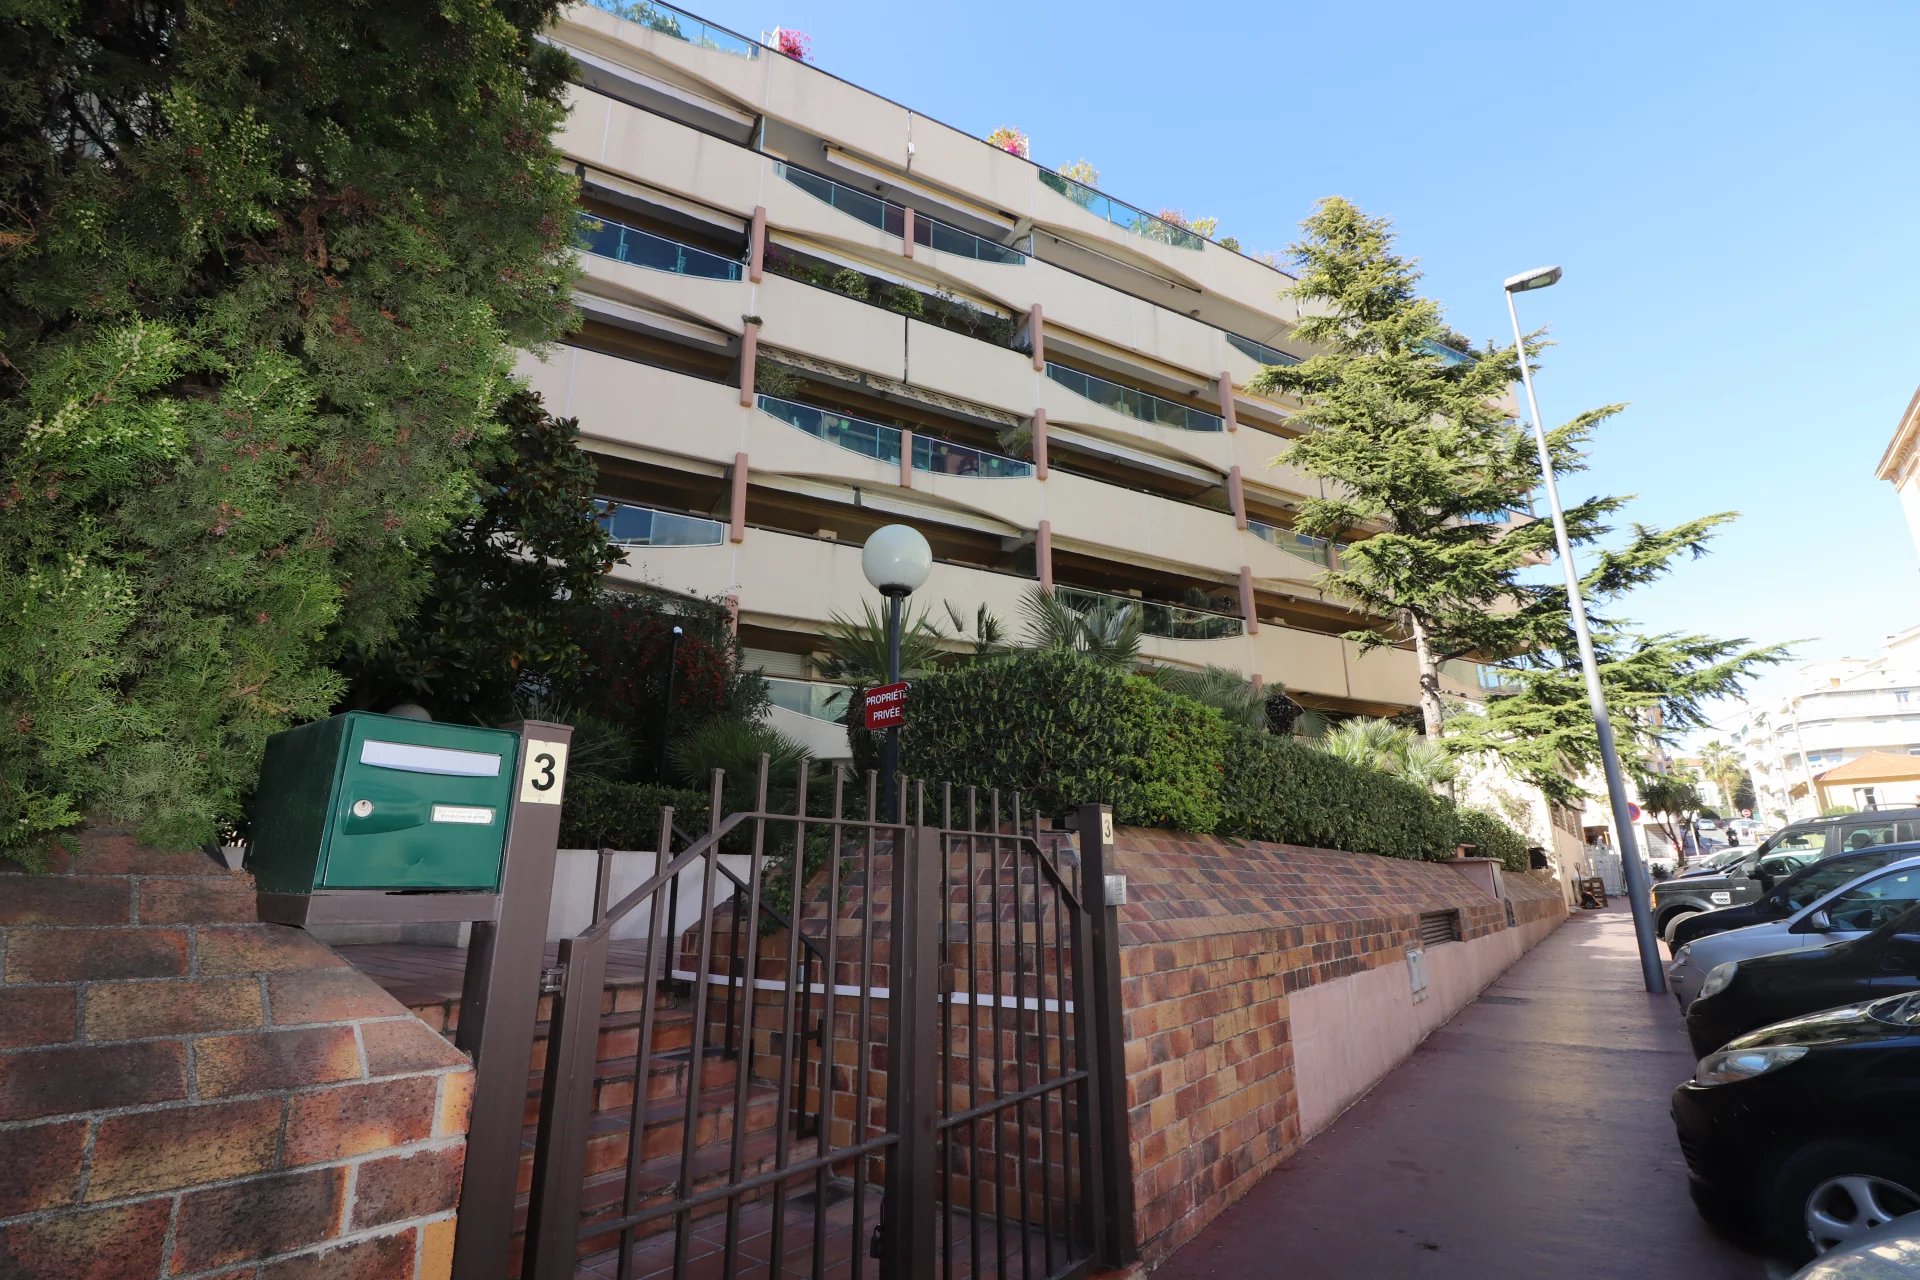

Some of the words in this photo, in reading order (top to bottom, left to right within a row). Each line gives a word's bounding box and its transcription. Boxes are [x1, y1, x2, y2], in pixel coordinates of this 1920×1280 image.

[873, 706, 901, 721] PRIVÉE
[531, 753, 556, 791] 3
[1104, 819, 1111, 838] 3
